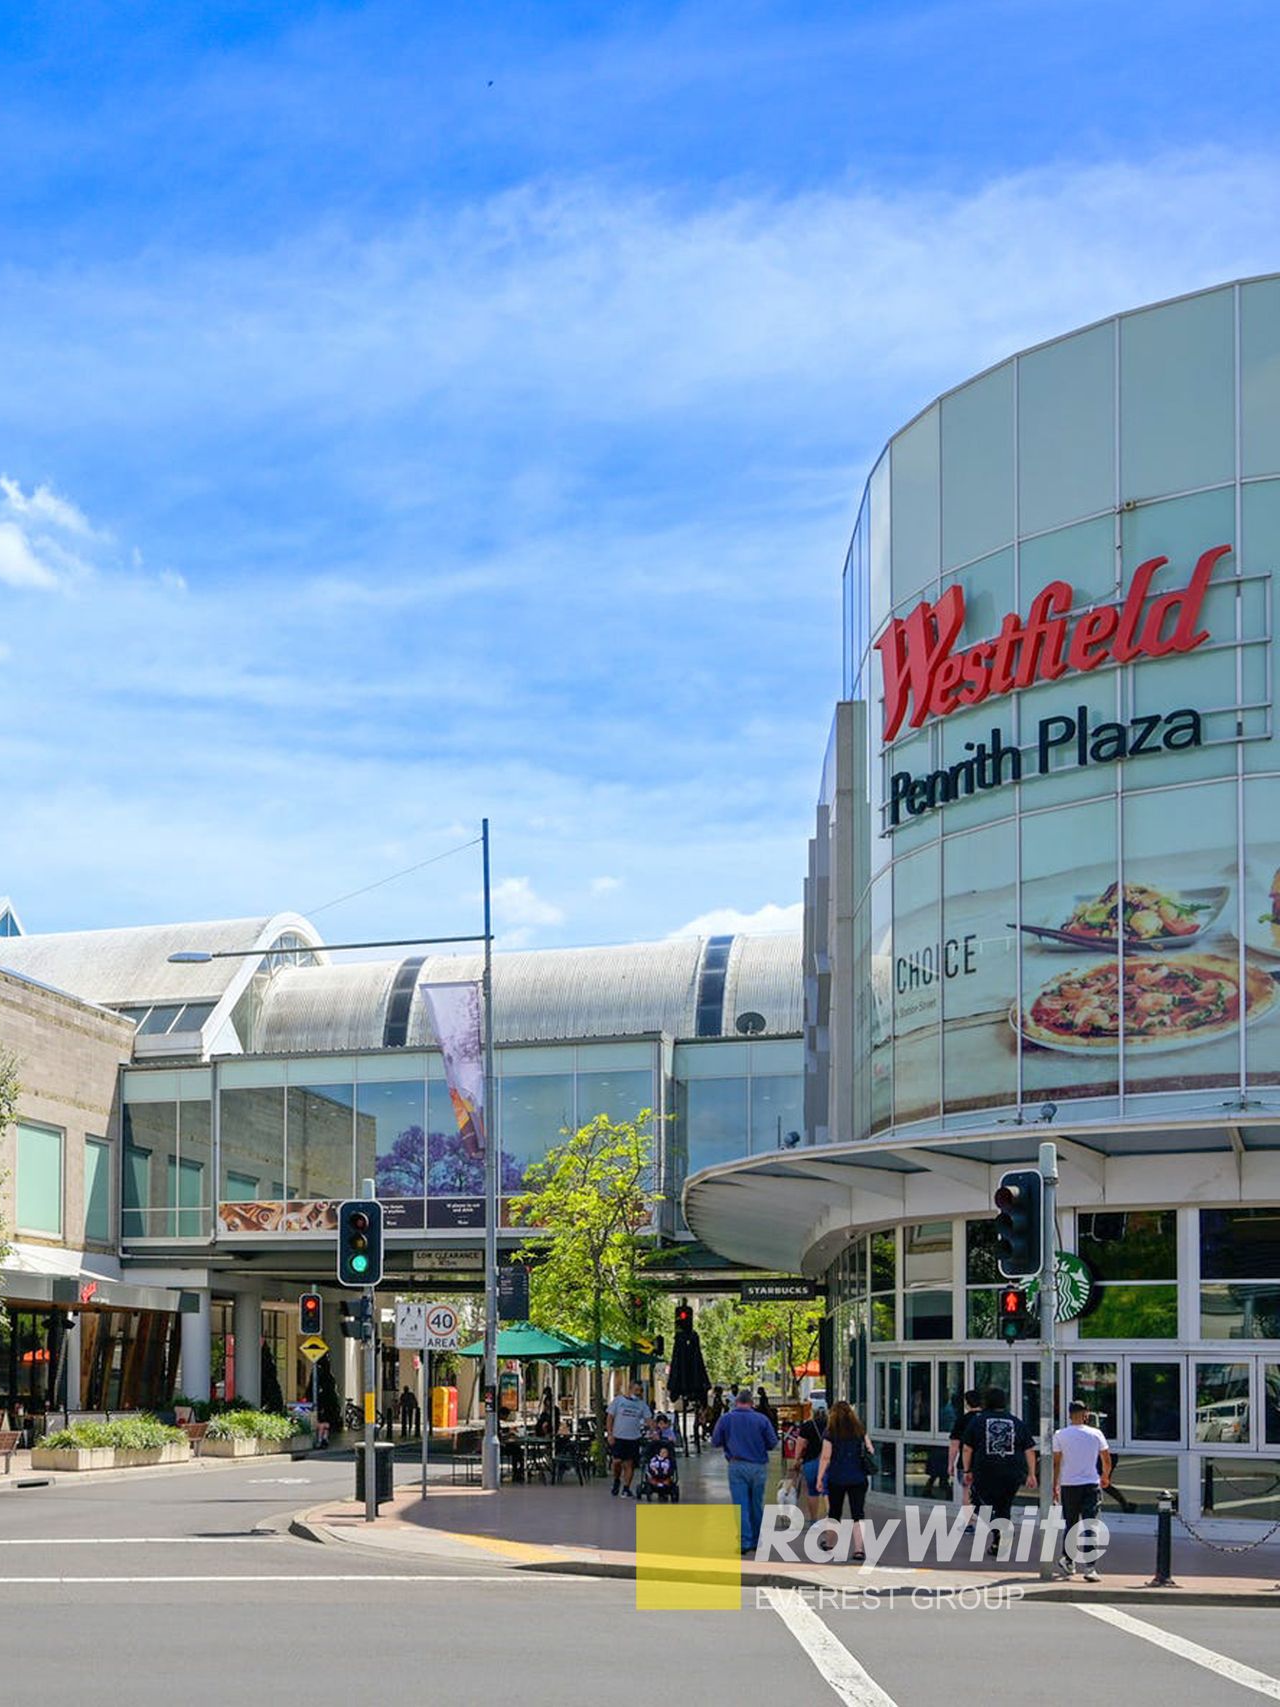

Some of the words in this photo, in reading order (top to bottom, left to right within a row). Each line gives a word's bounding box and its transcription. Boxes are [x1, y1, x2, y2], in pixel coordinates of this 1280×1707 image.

[874, 543, 1232, 742] Westfield
[890, 728, 1021, 825] Penrith
[1038, 705, 1202, 775] Plaza
[896, 934, 978, 995] CHOICE
[748, 1286, 809, 1294] STARBUCKS
[431, 1314, 453, 1329] 40
[427, 1338, 456, 1347] AREA
